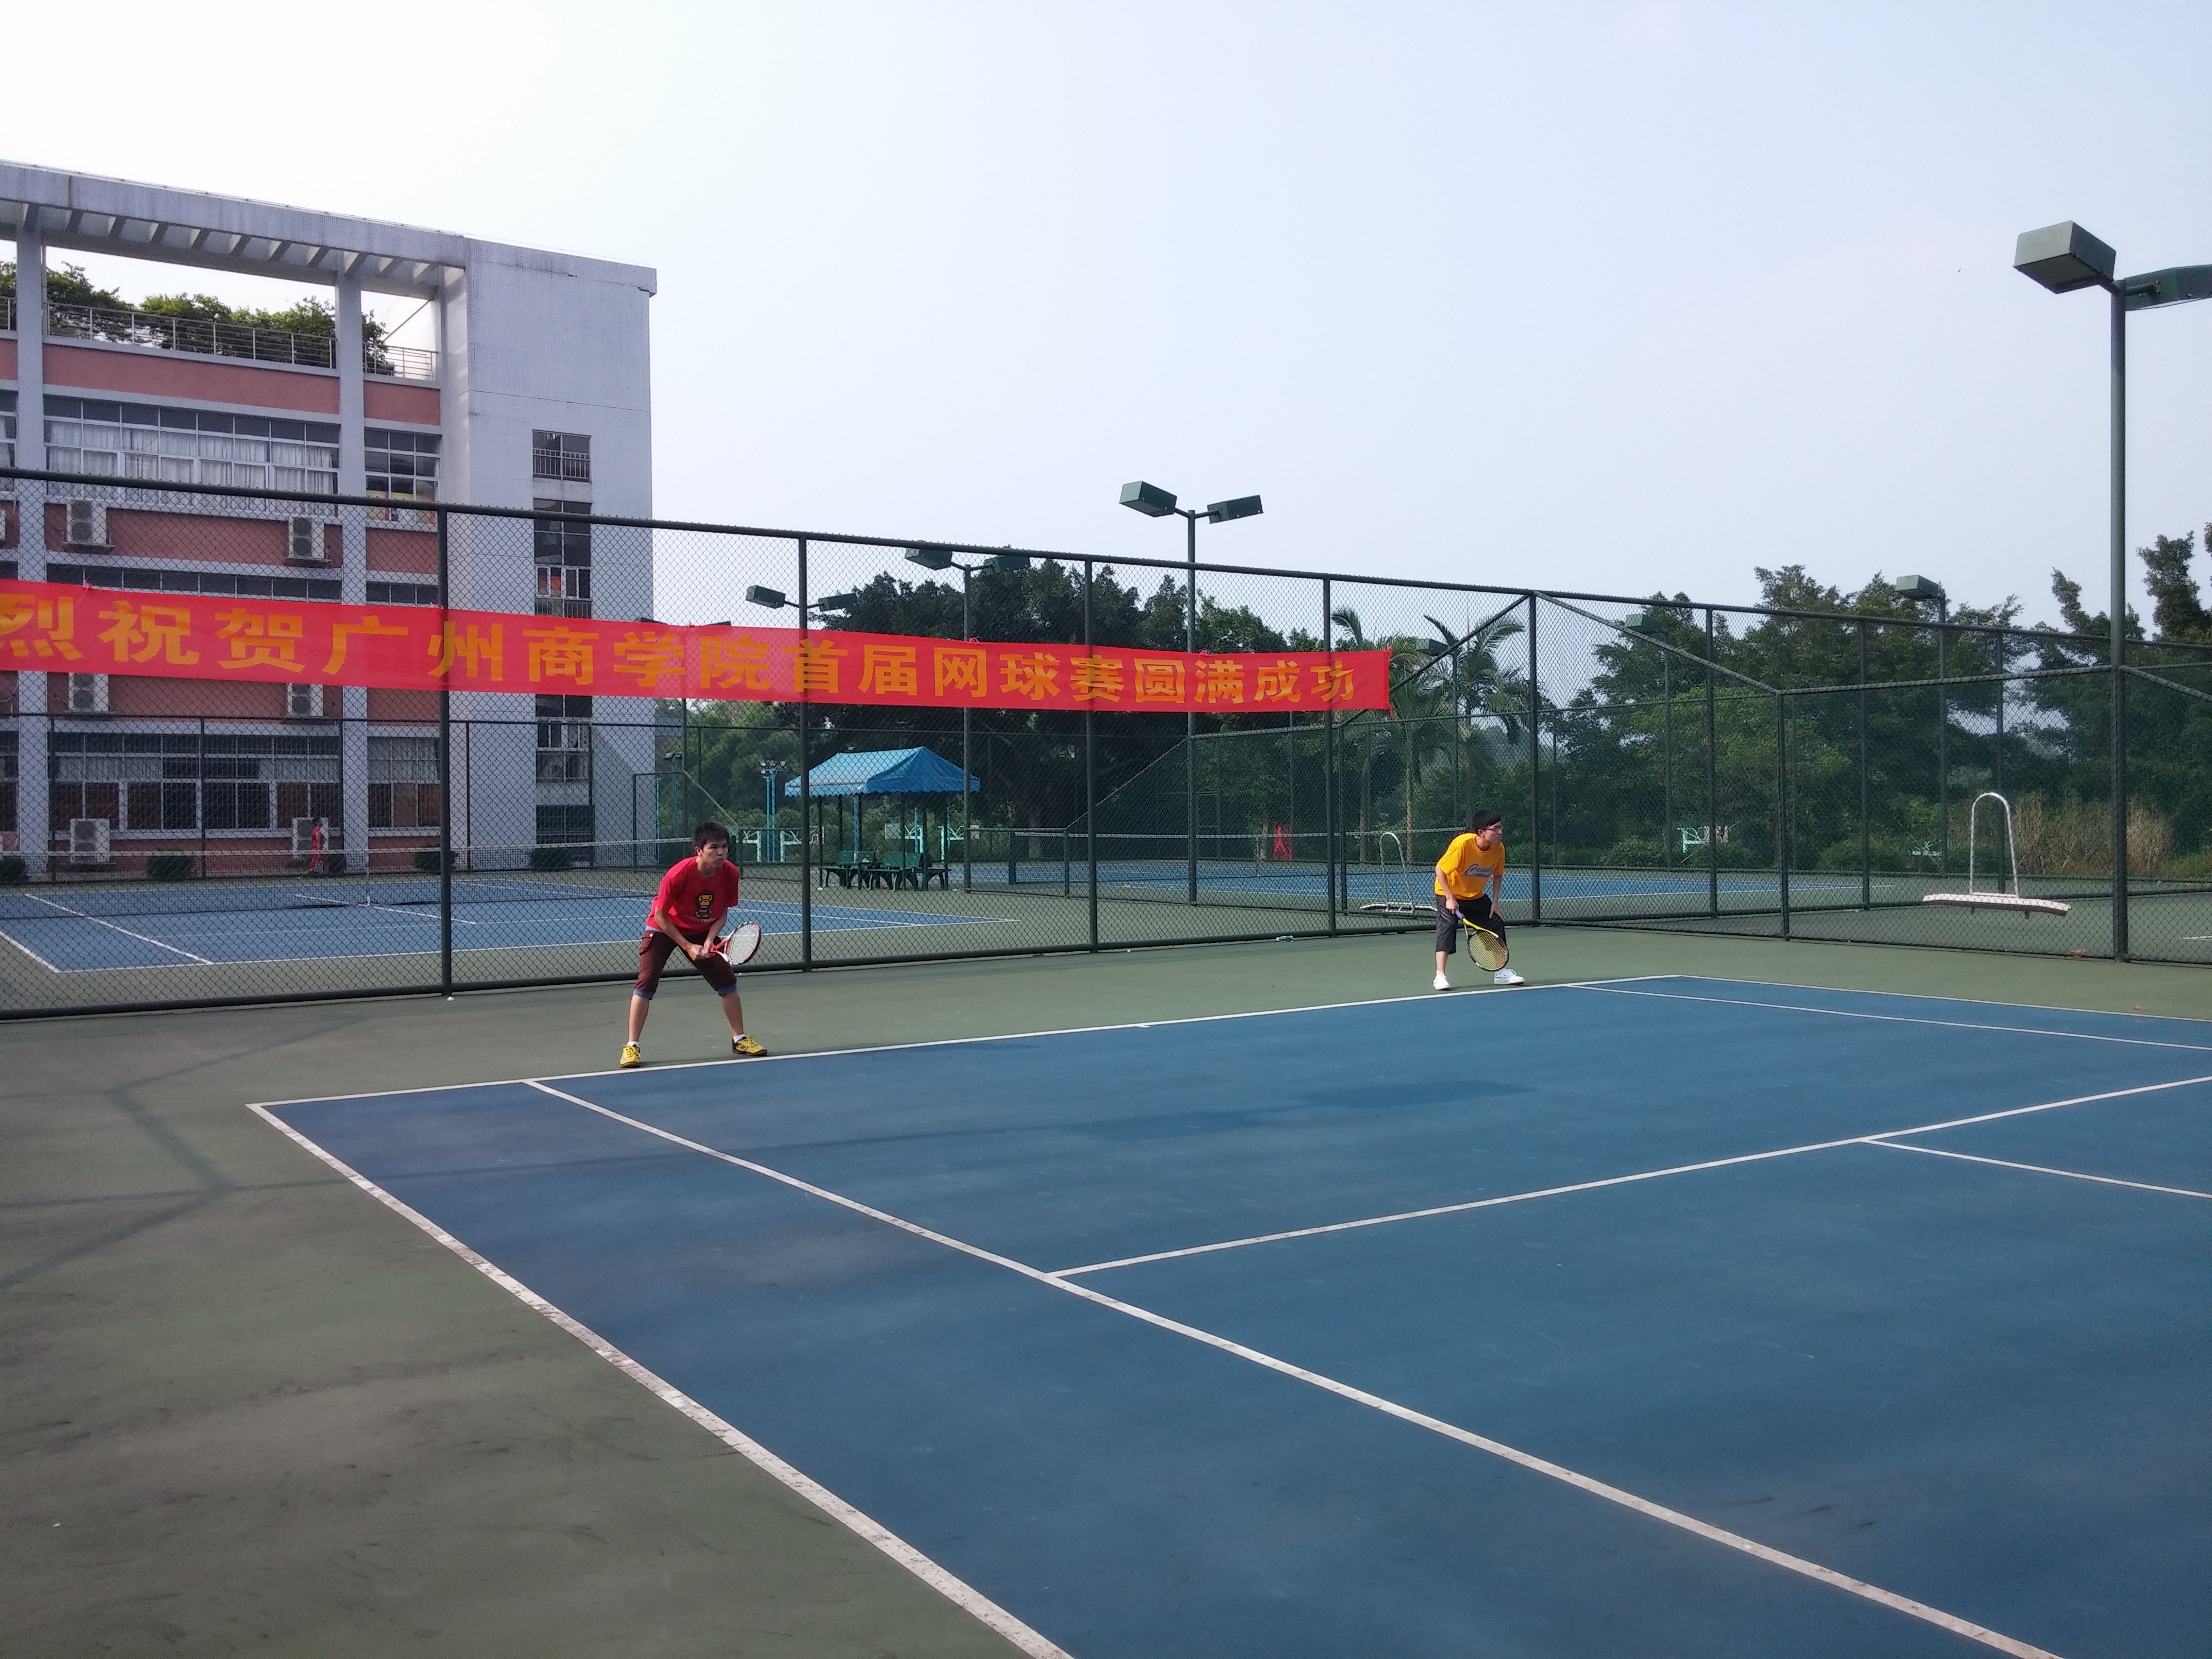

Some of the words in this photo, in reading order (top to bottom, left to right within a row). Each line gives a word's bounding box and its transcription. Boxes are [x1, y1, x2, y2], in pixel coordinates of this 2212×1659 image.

[0, 594, 1354, 703] 烈祝贺广州商学院首届网球赛圆满成功
